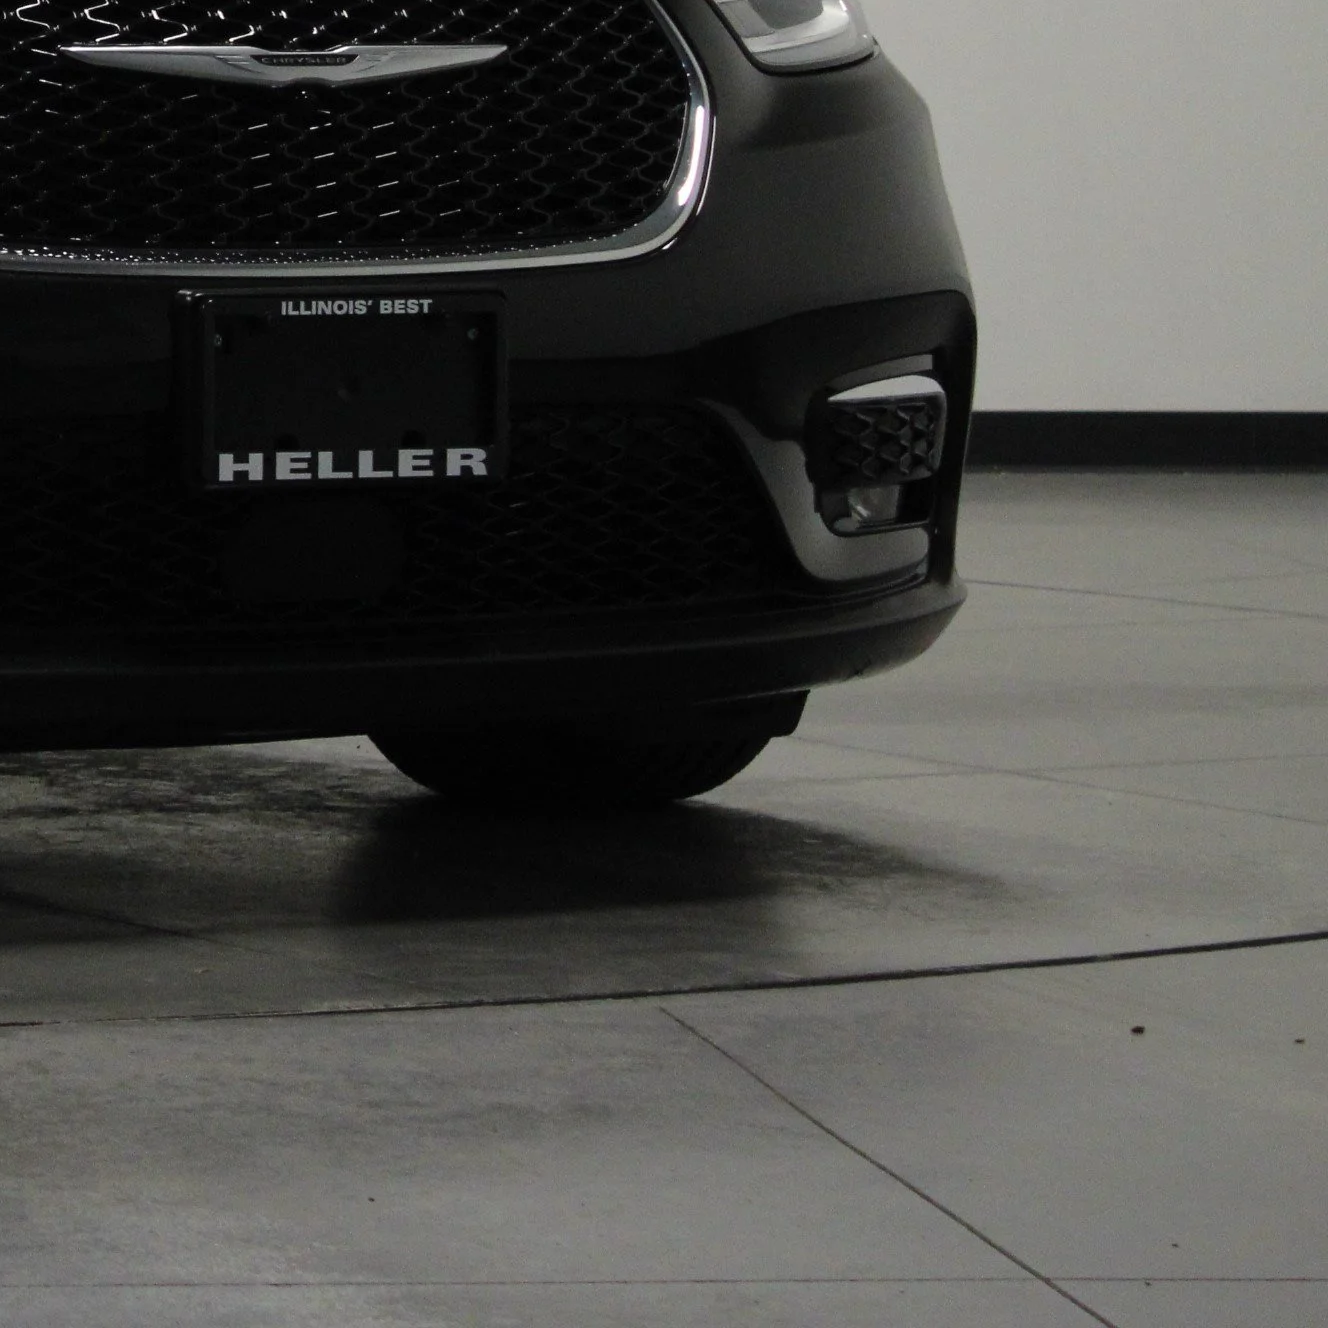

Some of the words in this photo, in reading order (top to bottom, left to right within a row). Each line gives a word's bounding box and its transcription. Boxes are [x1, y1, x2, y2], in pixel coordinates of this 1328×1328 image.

[260, 55, 348, 66] CHRYSLER
[378, 298, 434, 315] BEST
[217, 447, 489, 482] HELLER
